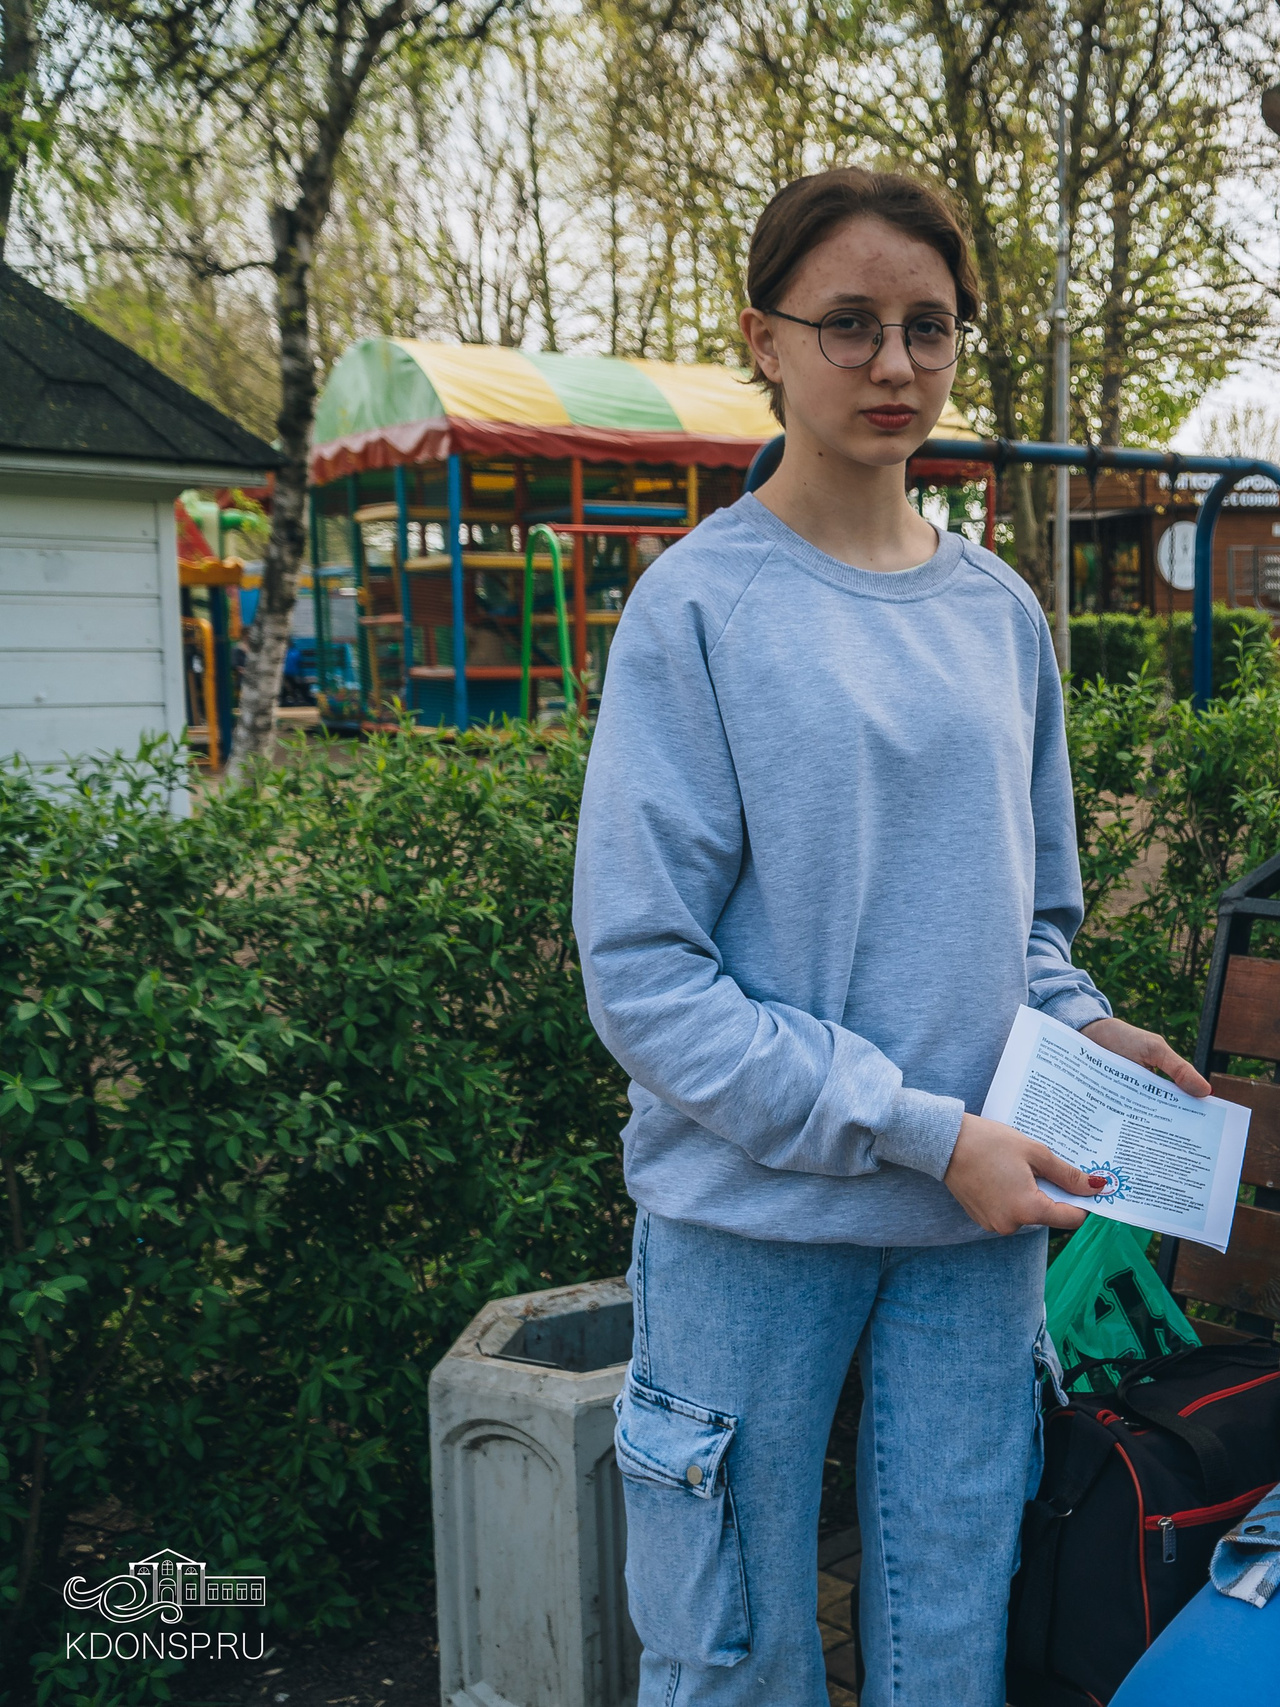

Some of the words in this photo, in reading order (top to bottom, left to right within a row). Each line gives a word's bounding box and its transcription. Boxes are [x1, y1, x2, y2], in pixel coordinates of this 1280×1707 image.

[1080, 1047, 1102, 1068] Умей
[1104, 1065, 1140, 1086] сказать
[1142, 1084, 1178, 1102] «НЕТ!»
[1086, 1092, 1106, 1107] Просто
[1106, 1105, 1125, 1116] скажи
[1126, 1114, 1150, 1124] «НЕТ!»
